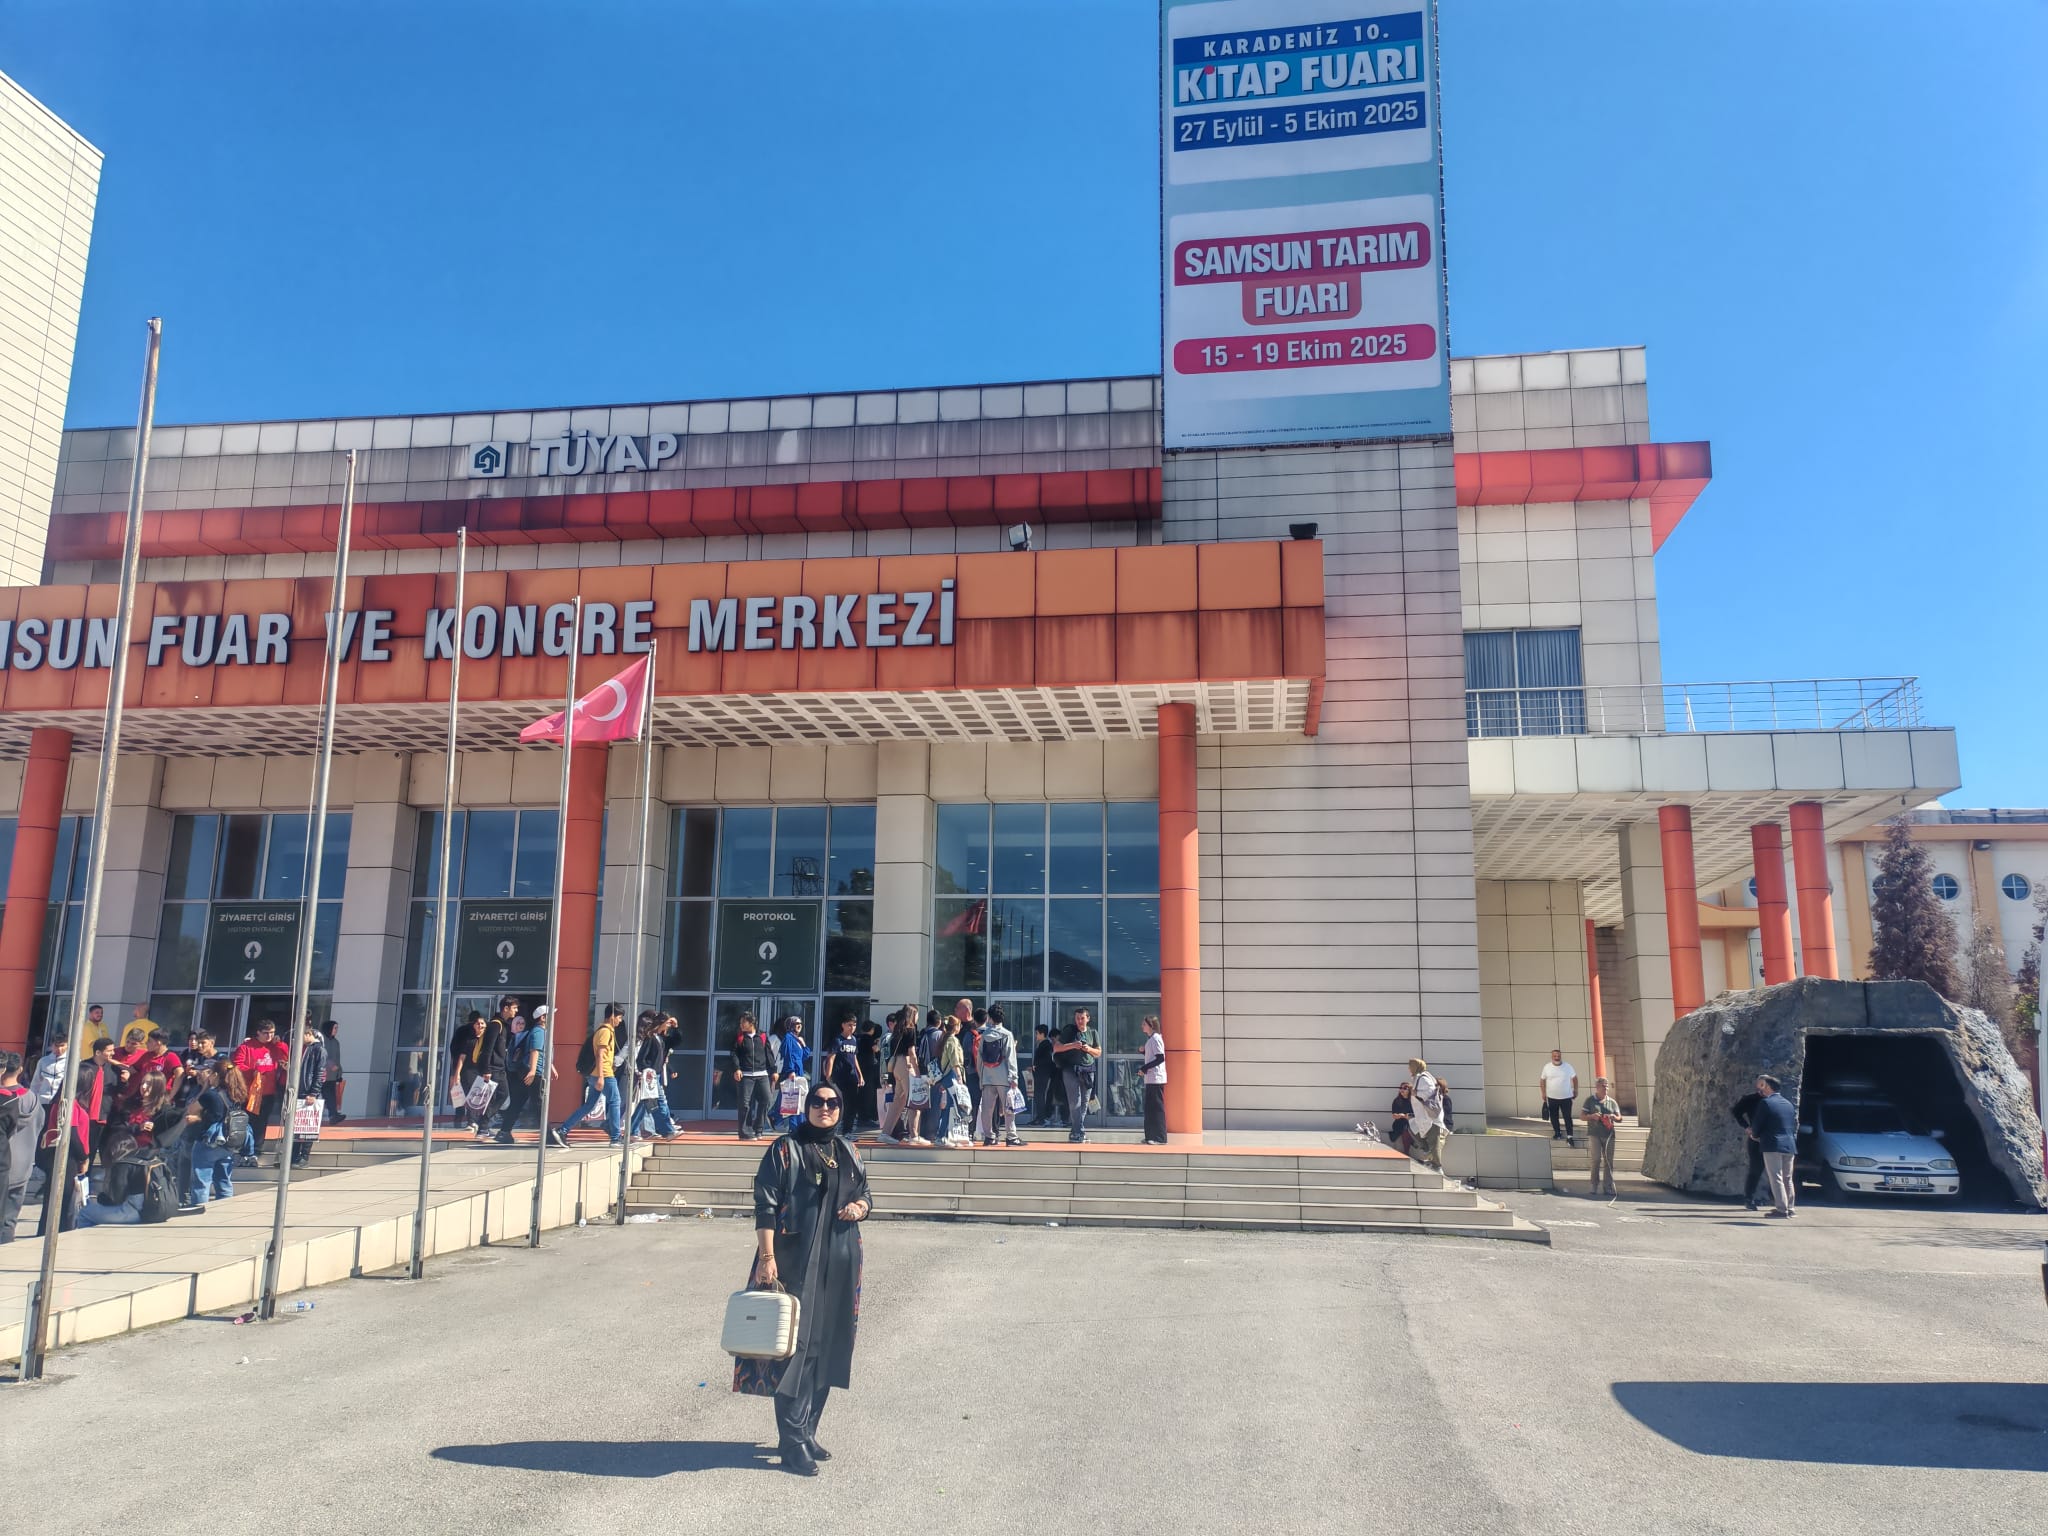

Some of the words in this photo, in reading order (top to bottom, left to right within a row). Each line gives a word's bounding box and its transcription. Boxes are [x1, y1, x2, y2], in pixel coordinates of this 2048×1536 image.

[1204, 26, 1338, 57] KARADENİZ
[1354, 23, 1390, 42] 10.
[1178, 61, 1290, 104] KİTAP
[1302, 45, 1417, 91] FUARI
[1180, 120, 1206, 142] 27
[1213, 115, 1263, 142] Eylül
[1285, 112, 1297, 133] 5
[1305, 105, 1357, 131] Ekim
[1364, 99, 1419, 126] 2025
[1184, 240, 1312, 278] SAMSUN
[1317, 230, 1419, 267] TARIM
[1255, 281, 1349, 318] FUARI
[1201, 345, 1228, 367] 15
[1252, 341, 1279, 364] 19
[1287, 337, 1342, 362] Ekim
[1350, 333, 1407, 357] 2025
[530, 429, 678, 476] TÜYAP
[0, 617, 120, 671] SUN
[147, 612, 291, 667] FUAR
[325, 610, 393, 661] VE
[423, 601, 655, 660] KONGRE
[687, 579, 956, 652] MERKEZİ
[219, 912, 267, 922] ZİYARETÇİ
[268, 912, 296, 923] GİRİŞİ
[469, 912, 518, 922] ZİYARETÇİ
[520, 912, 547, 922] GİRİŞİ
[743, 912, 797, 921] PROTOKOL
[244, 969, 256, 984] 4
[498, 969, 508, 984] 3
[760, 970, 772, 985] 2
